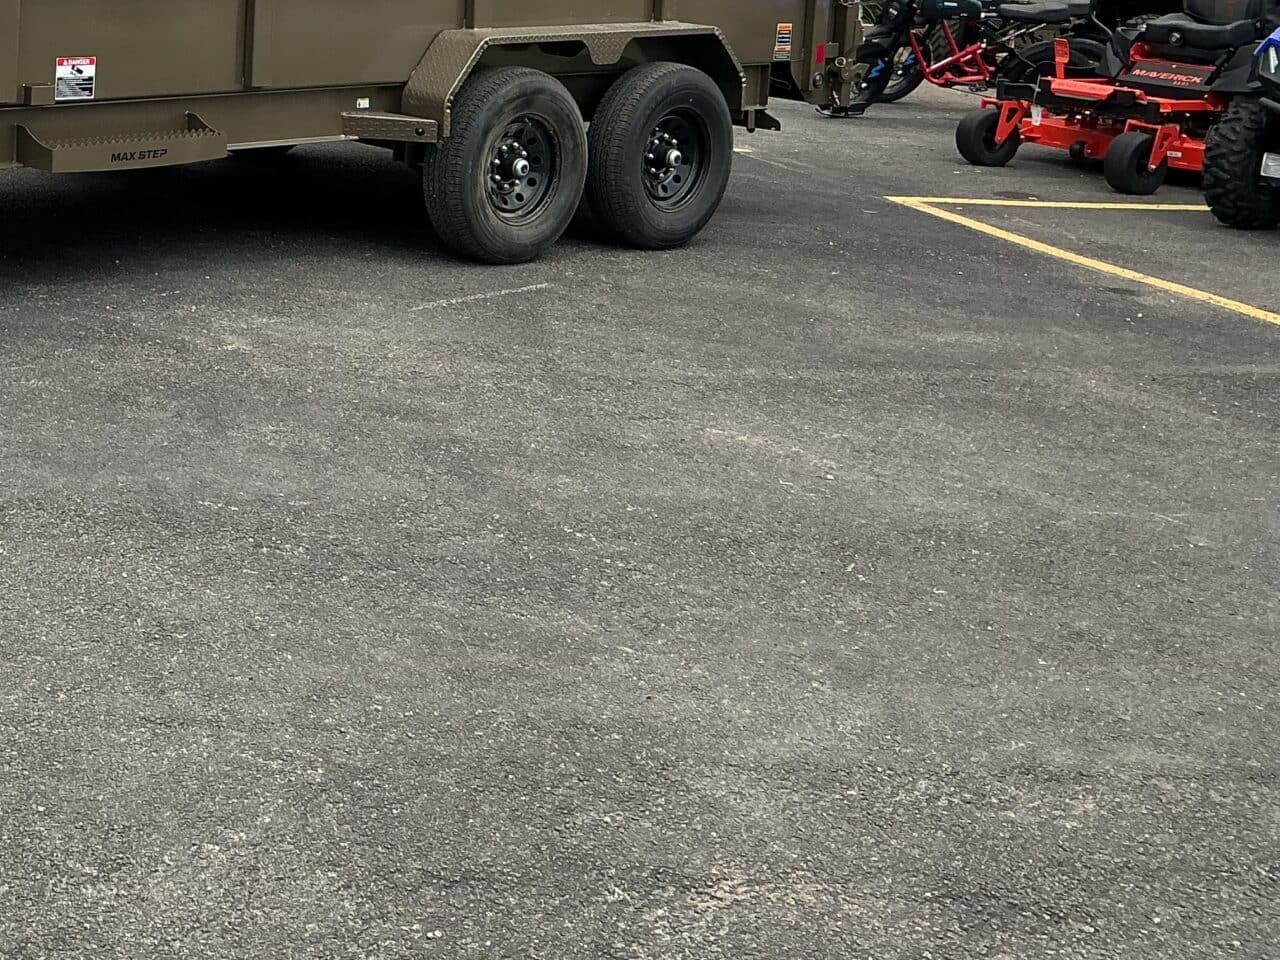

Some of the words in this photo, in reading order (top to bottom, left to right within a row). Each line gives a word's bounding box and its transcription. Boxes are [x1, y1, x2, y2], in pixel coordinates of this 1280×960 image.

[1132, 69, 1203, 83] MAVERICK
[111, 152, 137, 162] MAX
[138, 149, 168, 159] STEP
